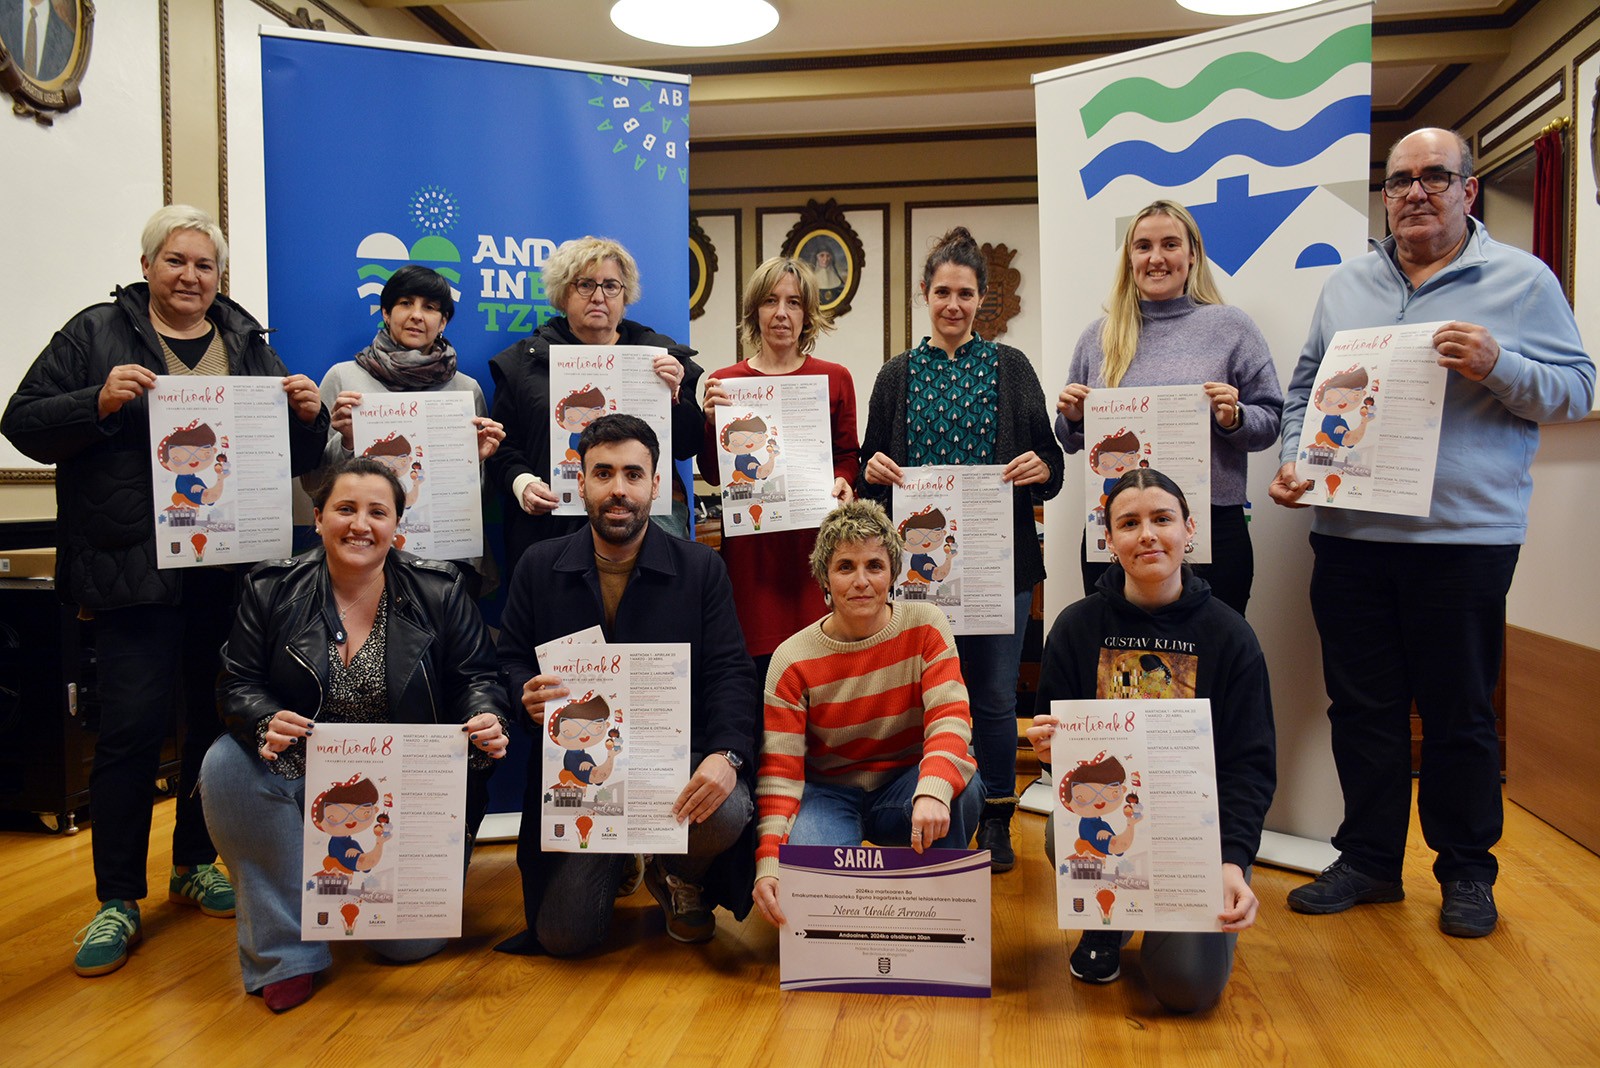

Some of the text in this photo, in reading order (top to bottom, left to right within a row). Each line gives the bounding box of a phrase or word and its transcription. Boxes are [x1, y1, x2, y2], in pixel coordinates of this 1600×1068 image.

[588, 96, 604, 108] A
[612, 96, 630, 108] B
[658, 88, 683, 106] AB
[639, 101, 655, 112] A
[596, 118, 614, 131] A
[623, 117, 640, 133] B
[662, 117, 672, 134] A
[612, 138, 628, 154] A
[642, 133, 656, 151] B
[666, 141, 676, 159] B
[634, 154, 647, 171] A
[657, 164, 667, 180] A
[678, 167, 687, 184] A
[1334, 334, 1392, 351] martxoak 8
[557, 354, 615, 370] martxoak 8
[158, 386, 225, 404] martxoak 8
[728, 385, 774, 401] artxoak 8
[360, 401, 418, 417] martxoak 8
[1091, 396, 1150, 413] martxoak 8
[899, 475, 955, 491] martxoak 8
[1104, 636, 1196, 652] GUSTAV KLIMT
[553, 656, 609, 674] martxoak
[611, 654, 621, 674] 8
[1060, 711, 1135, 733] martxoak 8
[317, 735, 393, 756] martxoak 8
[834, 848, 884, 869] SARIA
[833, 905, 936, 918] Nerea Uralde Arrondo
